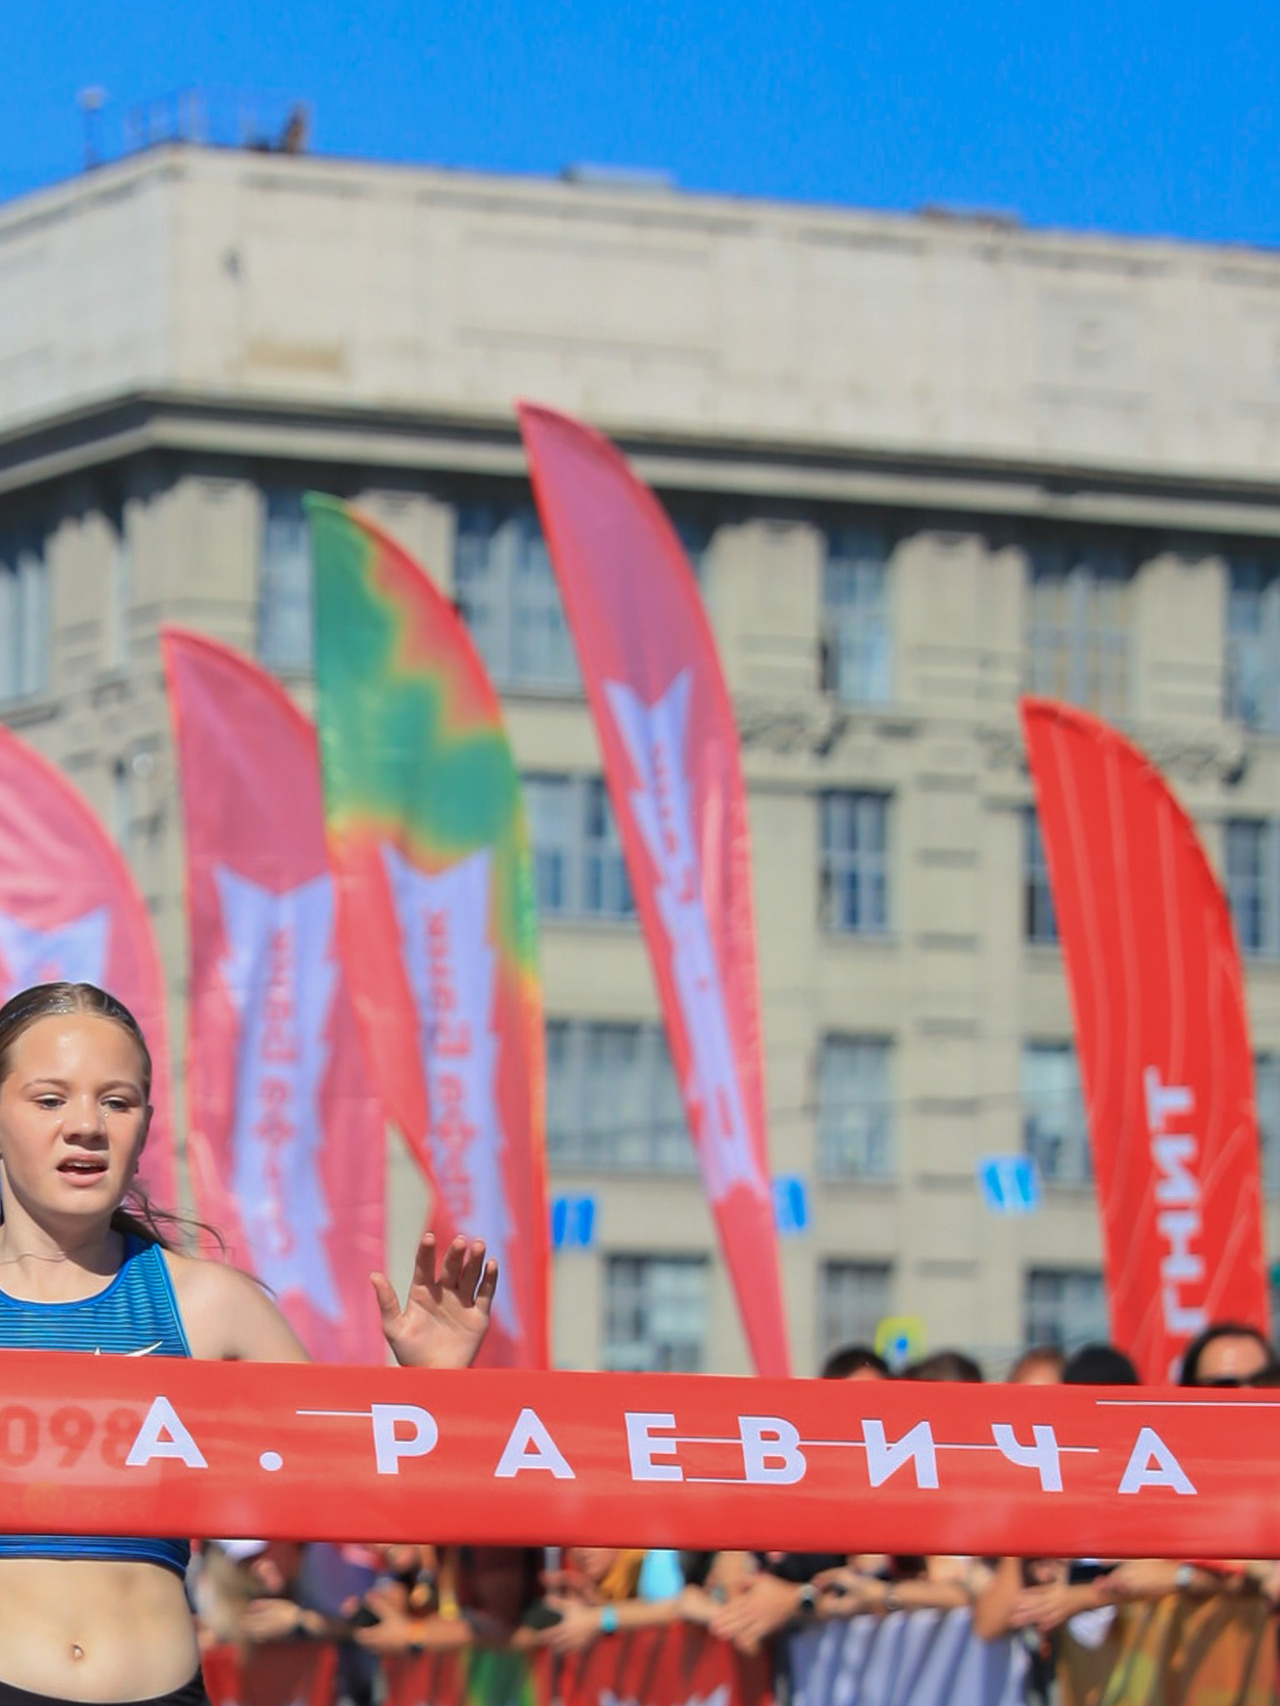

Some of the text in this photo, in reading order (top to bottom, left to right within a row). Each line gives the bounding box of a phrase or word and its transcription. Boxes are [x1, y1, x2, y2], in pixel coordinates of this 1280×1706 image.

[1144, 1064, 1207, 1386] ГНИТ
[125, 1395, 283, 1473] А.
[370, 1403, 1199, 1495] РАЕВИЧА
